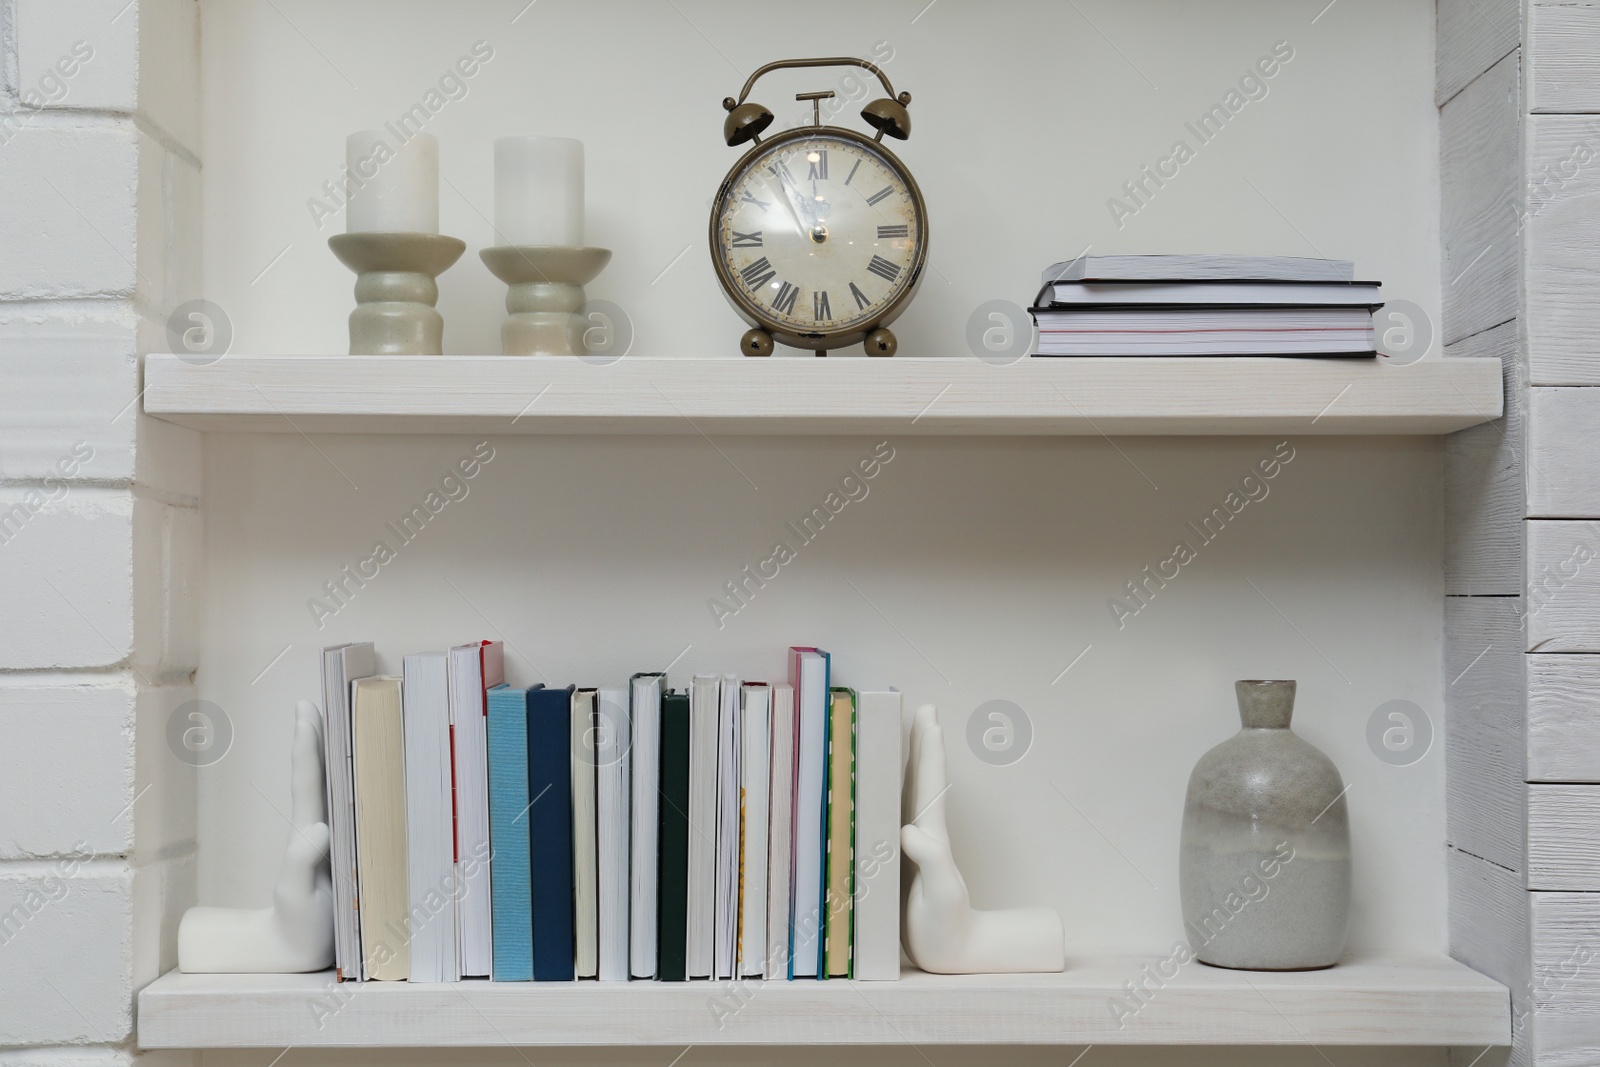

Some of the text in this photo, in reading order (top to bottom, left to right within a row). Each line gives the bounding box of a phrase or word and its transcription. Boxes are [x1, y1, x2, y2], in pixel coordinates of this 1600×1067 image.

[866, 184, 895, 207] II
[732, 231, 763, 248] IX
[876, 224, 909, 239] III
[739, 256, 777, 293] VIII
[866, 254, 902, 283] IIII
[771, 280, 800, 316] VII
[813, 291, 833, 321] VI
[848, 281, 872, 311] V
